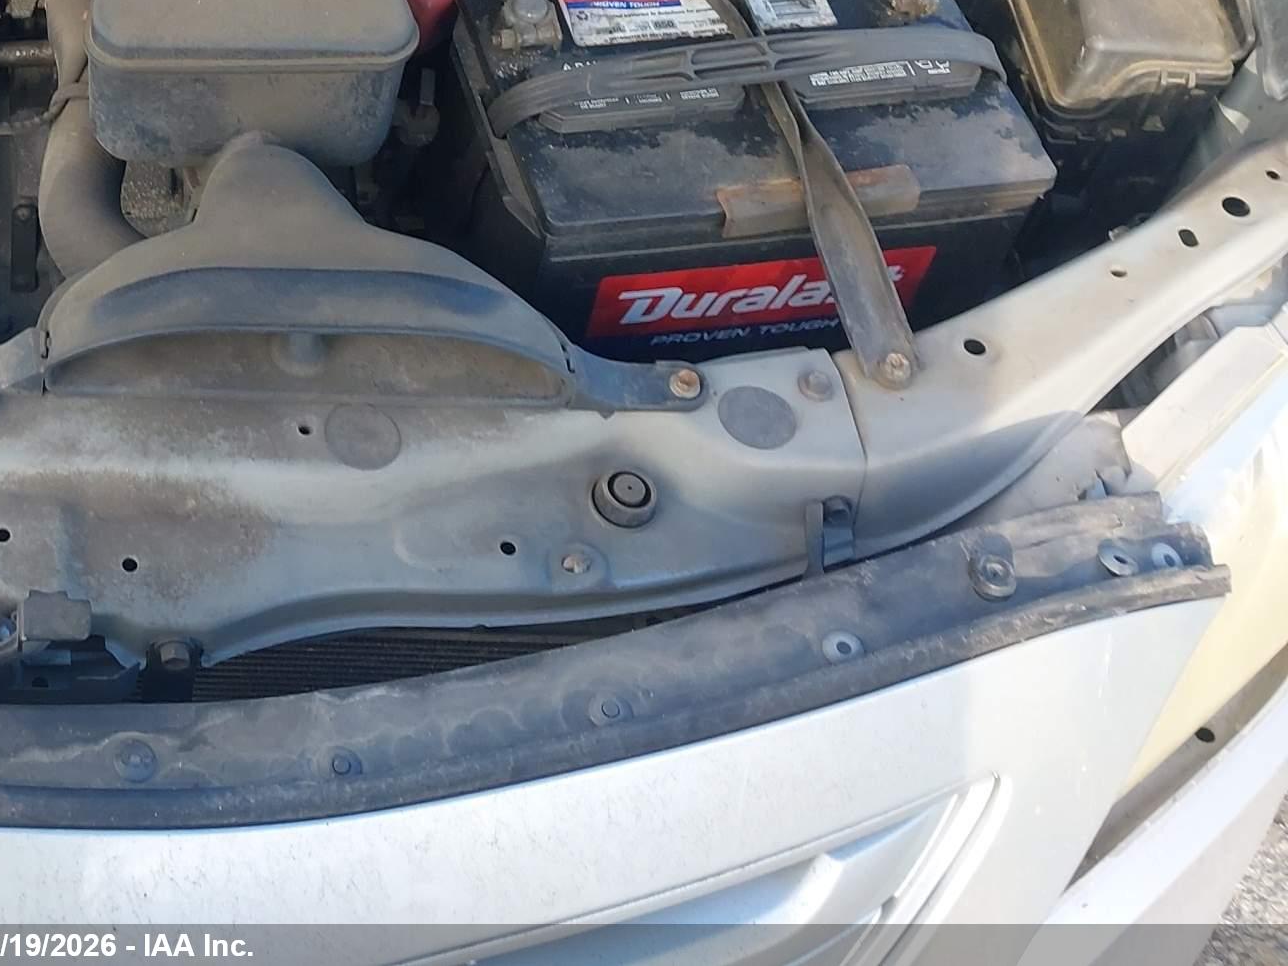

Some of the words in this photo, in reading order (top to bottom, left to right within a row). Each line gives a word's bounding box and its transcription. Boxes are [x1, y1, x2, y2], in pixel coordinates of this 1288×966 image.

[618, 264, 906, 326] Durala
[650, 327, 752, 347] PROVEN
[760, 318, 840, 337] TOUGH
